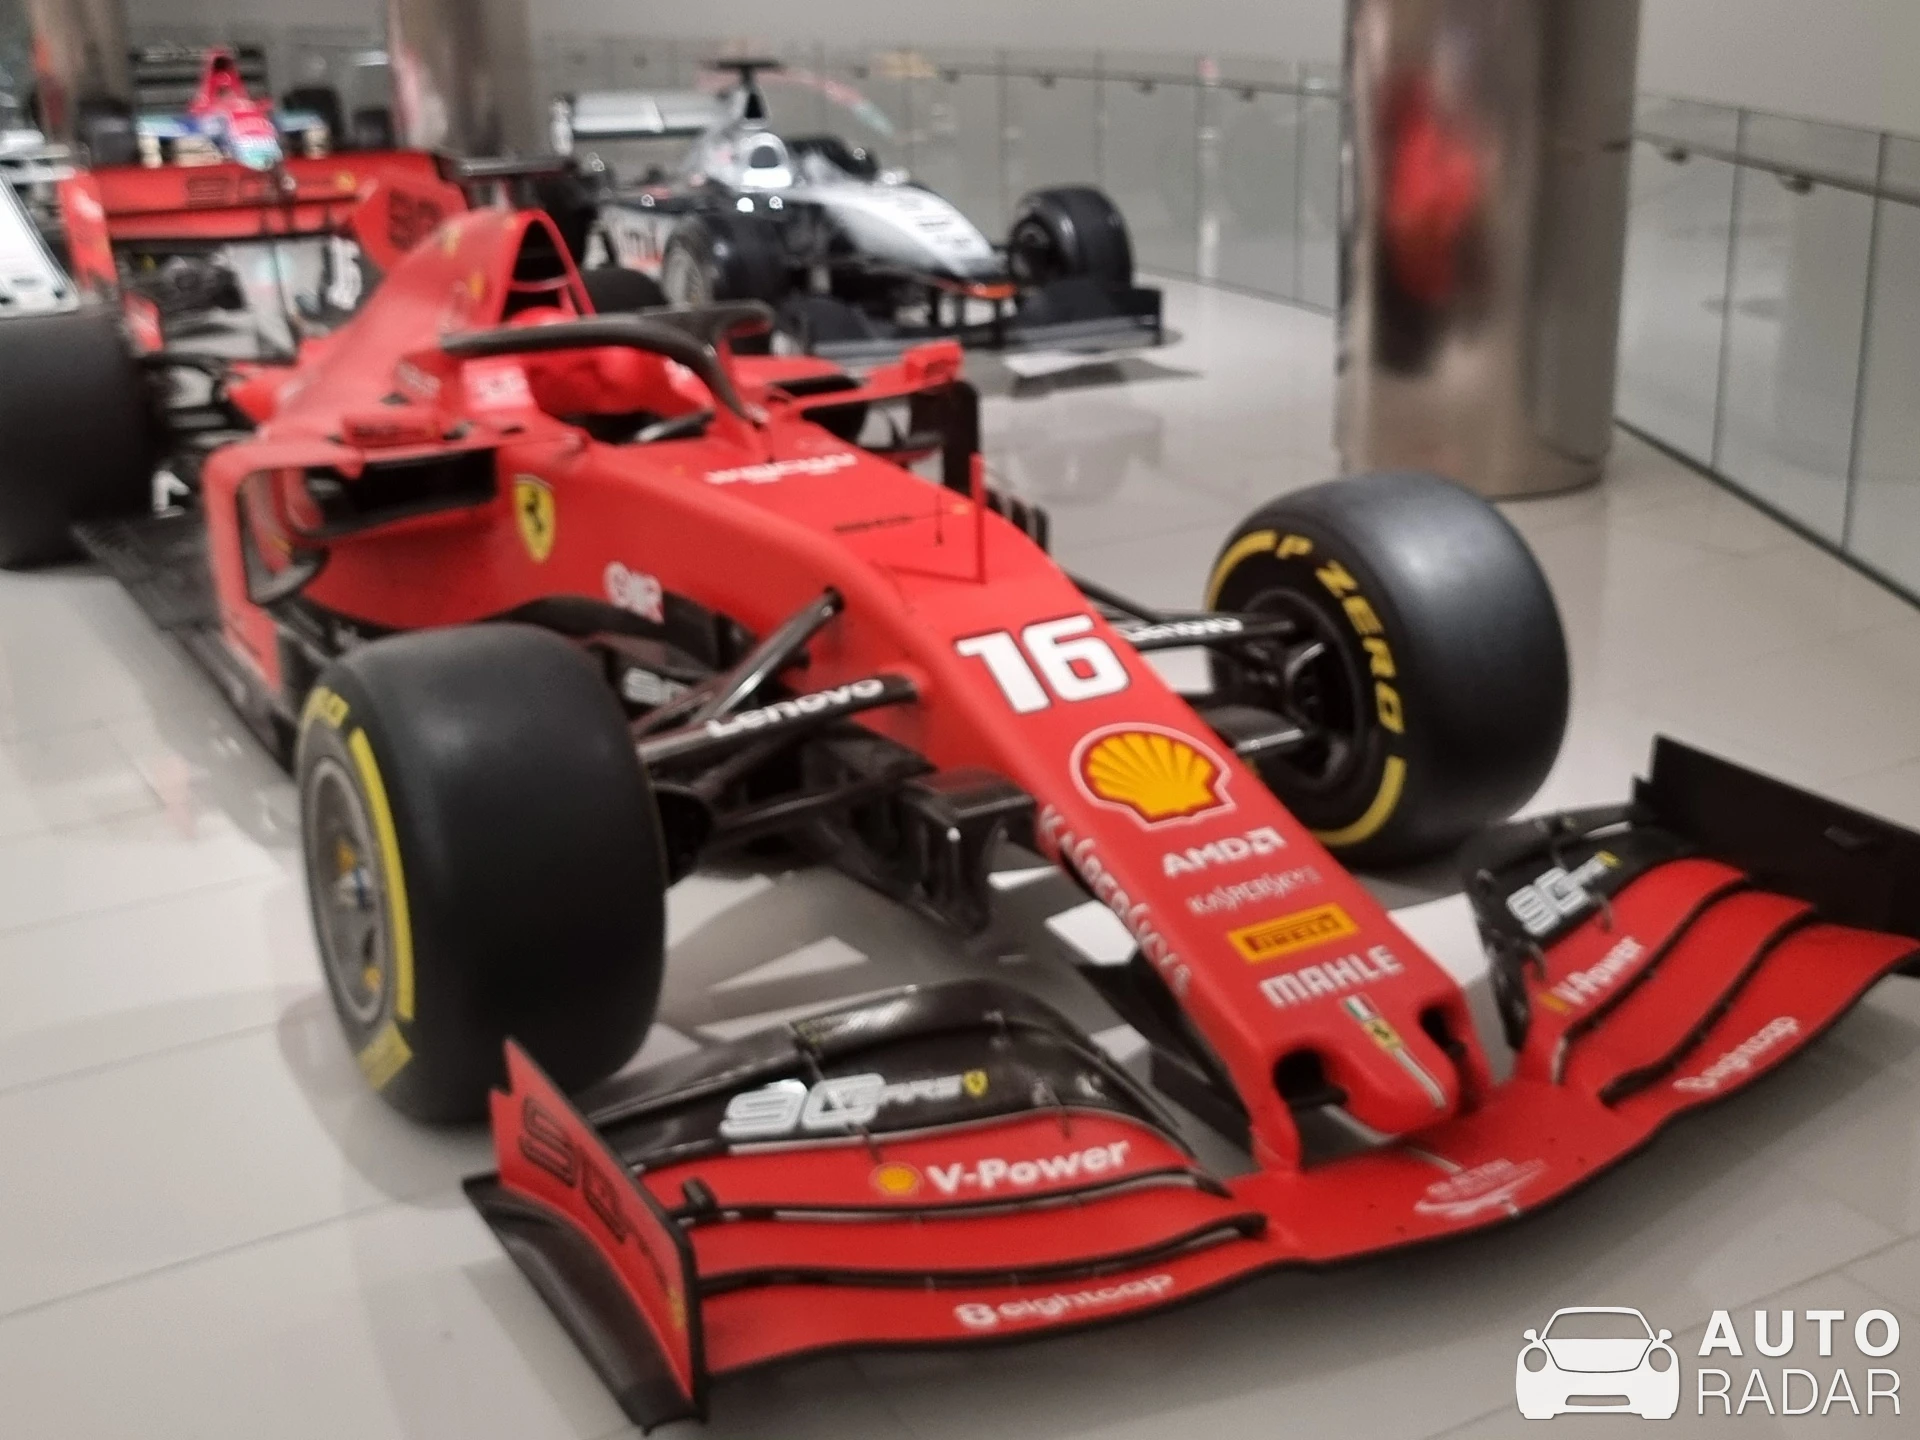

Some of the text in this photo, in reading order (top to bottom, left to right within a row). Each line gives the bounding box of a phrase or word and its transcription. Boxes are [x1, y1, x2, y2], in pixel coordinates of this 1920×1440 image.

[953, 613, 1132, 716] 16
[1315, 559, 1405, 735] ZERO
[1162, 834, 1256, 879] AMD
[1259, 943, 1405, 1009] MAHLE
[925, 1138, 1131, 1195] V-Power
